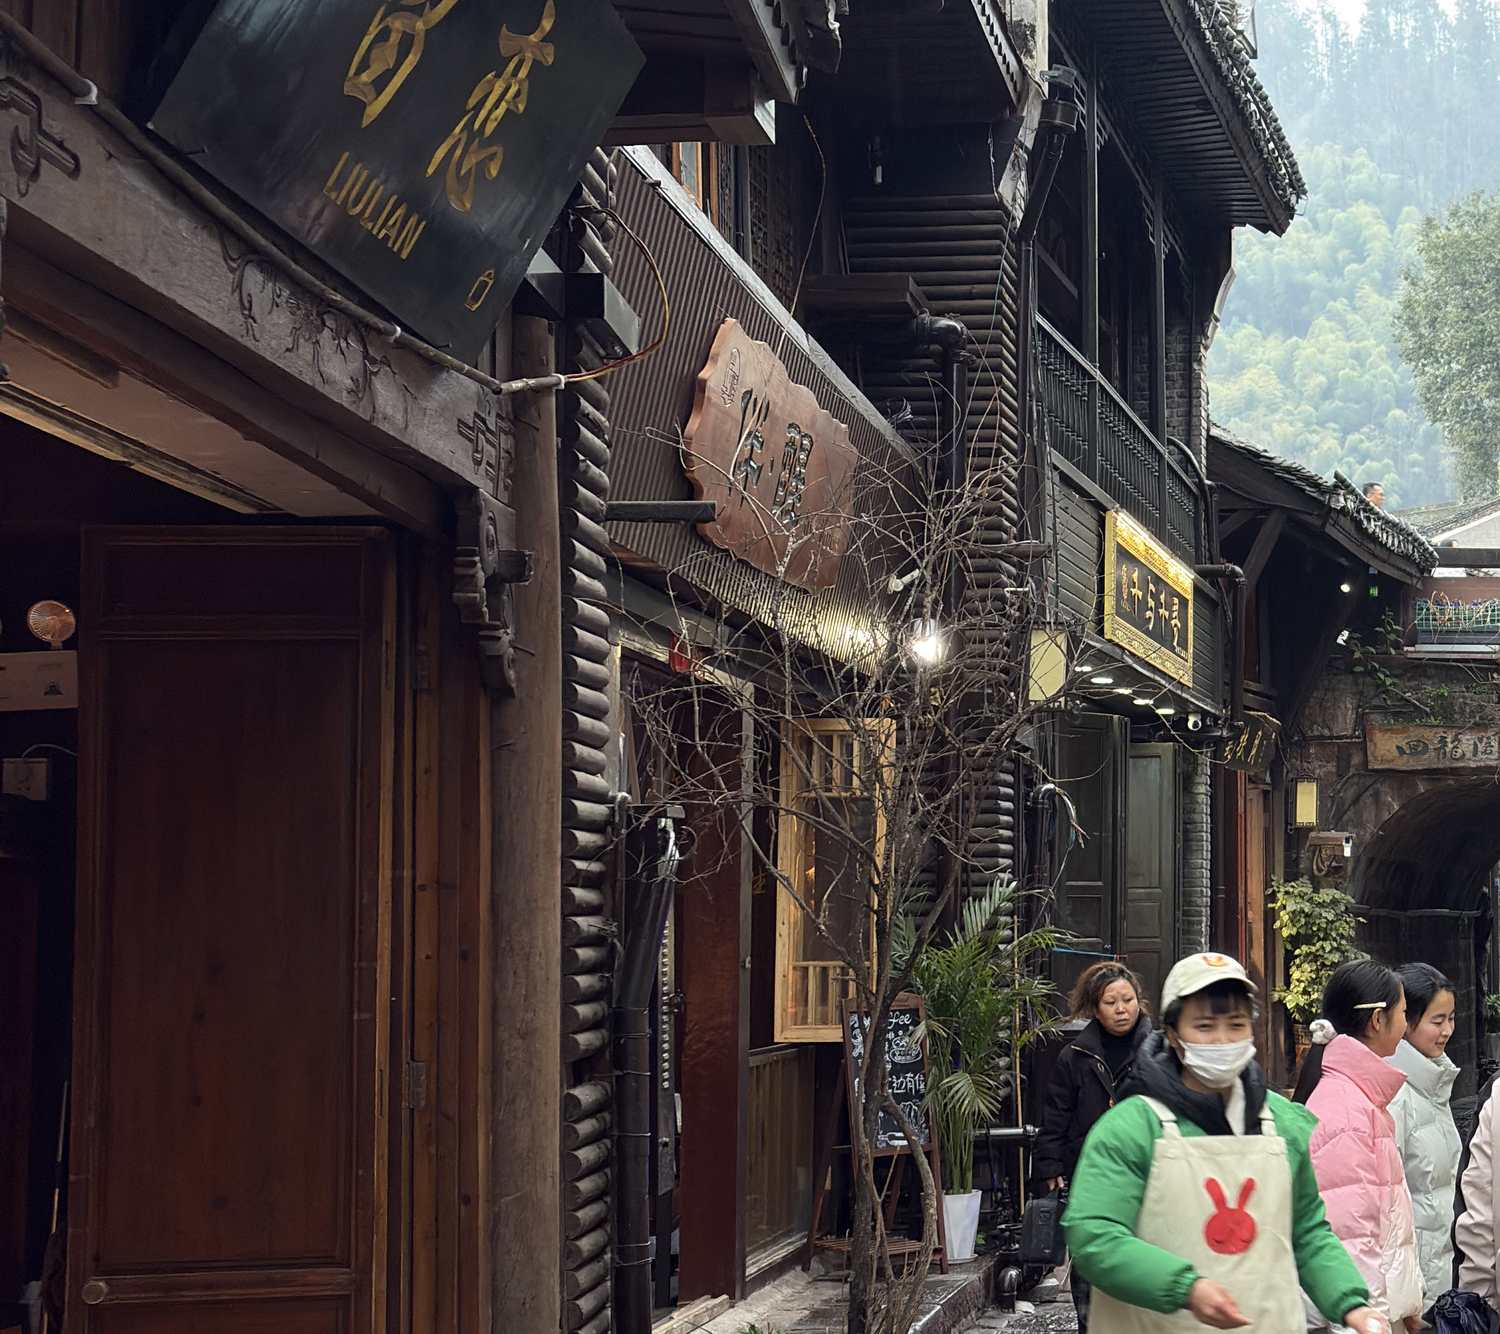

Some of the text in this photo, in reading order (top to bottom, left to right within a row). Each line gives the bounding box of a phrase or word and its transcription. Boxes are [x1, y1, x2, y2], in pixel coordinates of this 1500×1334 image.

[323, 151, 427, 260] LIULIAN
[888, 1072, 926, 1095] 边有位
